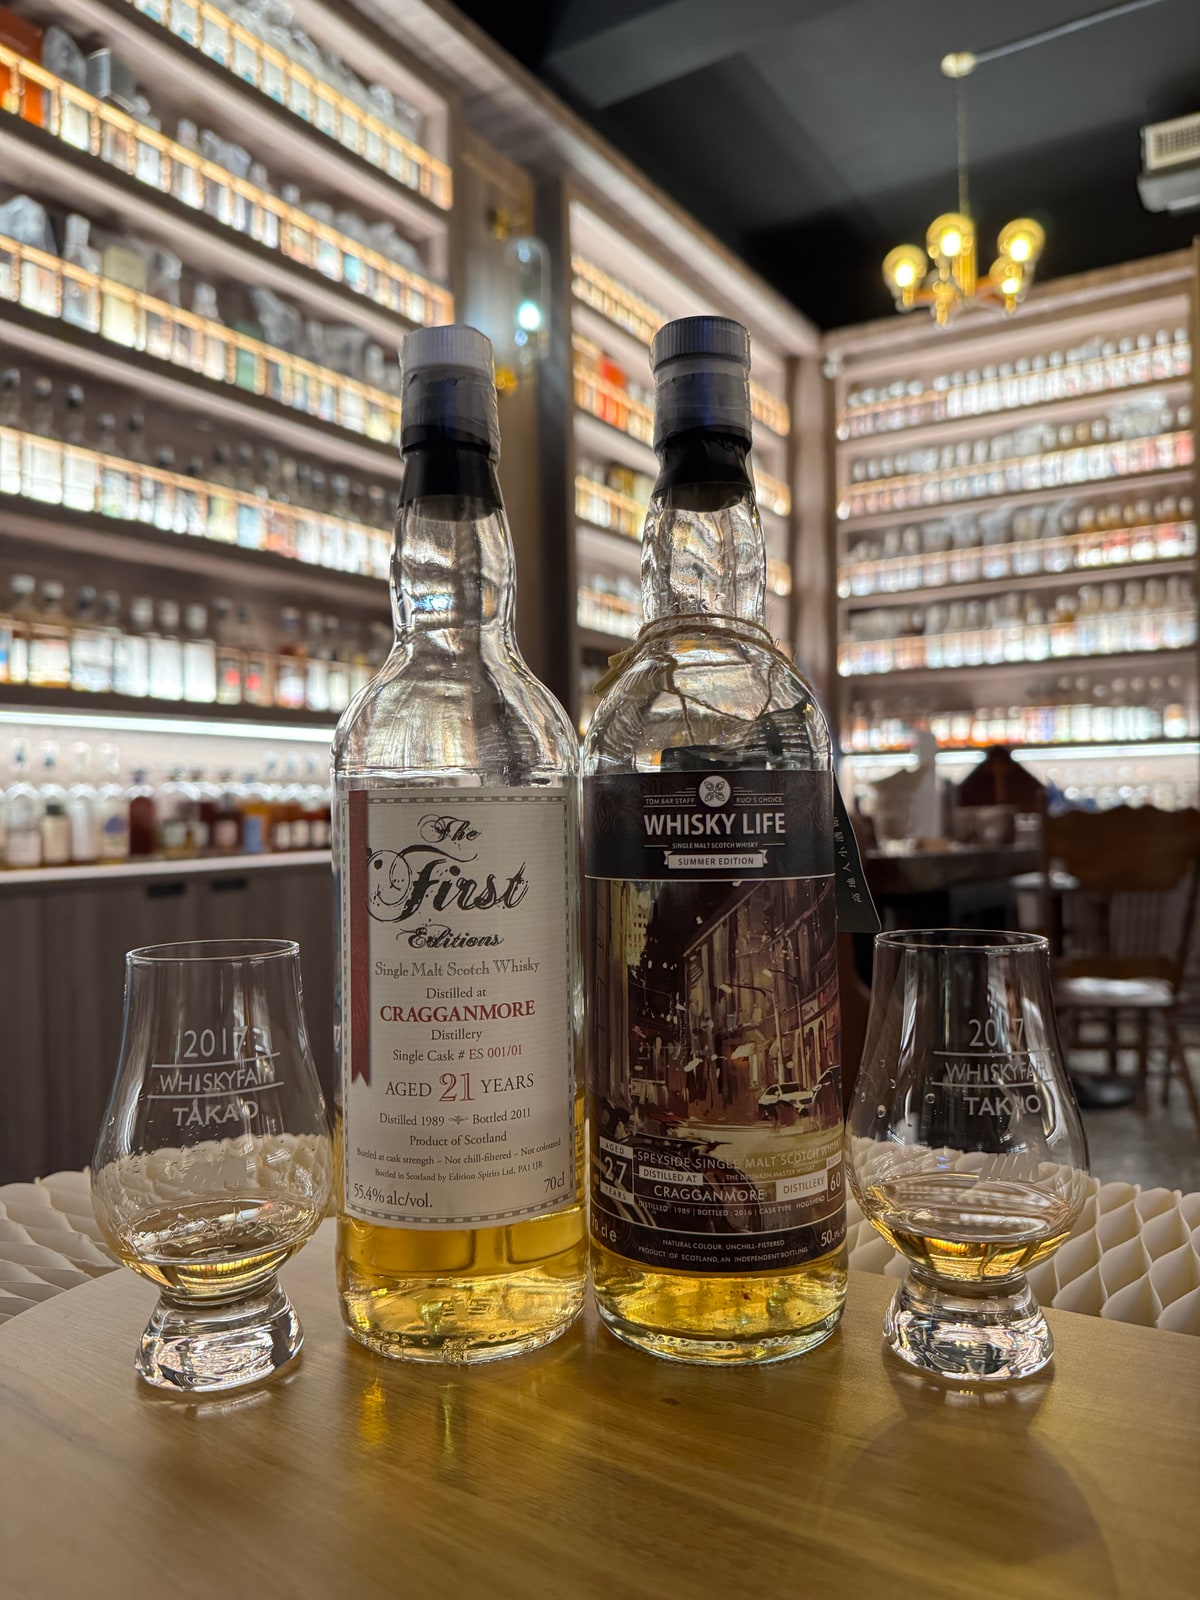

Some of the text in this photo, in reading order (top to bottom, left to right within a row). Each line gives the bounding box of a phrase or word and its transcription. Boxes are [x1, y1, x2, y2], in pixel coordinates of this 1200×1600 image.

[417, 814, 483, 845] The
[643, 812, 786, 836] WHISKY LIFE
[678, 857, 754, 866] SUMMER EDITION
[367, 844, 530, 923] First
[396, 923, 504, 949] Editions
[375, 957, 540, 979] Single Malt Scotch Whisky
[426, 987, 487, 999] Distilled at
[380, 1000, 536, 1023] CRAGGANMORE
[183, 1026, 248, 1058] 2017
[431, 1028, 483, 1042] Distillery
[968, 1018, 1024, 1048] 207
[393, 1049, 424, 1064] Single
[427, 1050, 455, 1062] Cask
[469, 1048, 484, 1060] ES
[488, 1044, 523, 1058] 001/01
[385, 1072, 535, 1102] AGED 21 YEARS
[172, 1101, 259, 1126] TAKAO
[379, 1107, 531, 1127] Distilled 1989 Bottled 2011
[410, 1130, 507, 1147] Product of Scotland
[605, 1142, 625, 1155] AGED
[356, 1147, 377, 1160] Bottled
[386, 1154, 401, 1163] cask
[403, 1156, 435, 1167] strength
[445, 1155, 461, 1165] Not
[463, 1150, 512, 1164] chill-filtered
[521, 1147, 535, 1157] Not
[536, 1137, 561, 1153] coloured
[637, 1151, 690, 1168] SPEYSIDE
[695, 1158, 740, 1170] SINGLE
[745, 1156, 777, 1169] MALT
[780, 1149, 819, 1165] SCOTCH
[375, 1168, 396, 1179] Bottled
[398, 1171, 405, 1180] in
[406, 1172, 436, 1181] Scotland
[438, 1173, 447, 1182] by
[449, 1172, 476, 1181] Edition
[478, 1170, 500, 1180] Spirits
[604, 1156, 627, 1184] 27
[643, 1168, 698, 1183] DISTILLED AT
[773, 1170, 796, 1178] MASTER
[543, 1171, 566, 1193] 70cl
[653, 1176, 825, 1203] CRAGGANMORE DISTILLERY
[830, 1172, 841, 1192] 60
[354, 1183, 433, 1208] 55.4% alc/vol.
[605, 1186, 627, 1201] YEARS
[639, 1201, 668, 1212] DISTILLED
[674, 1206, 691, 1214] 1989
[697, 1208, 729, 1217] BOTTLED
[734, 1209, 752, 1217] 2016
[759, 1207, 776, 1215] CASK
[777, 1205, 792, 1213] TYPE
[591, 1213, 599, 1231] 70
[638, 1246, 667, 1258] PRODUCT
[668, 1252, 679, 1260] OF
[734, 1253, 780, 1263] INDEPENDENT
[781, 1247, 809, 1258] BOTTLING
[662, 1239, 692, 1249] NATURAL
[726, 1239, 785, 1250] UNCHILL-FILTERED
